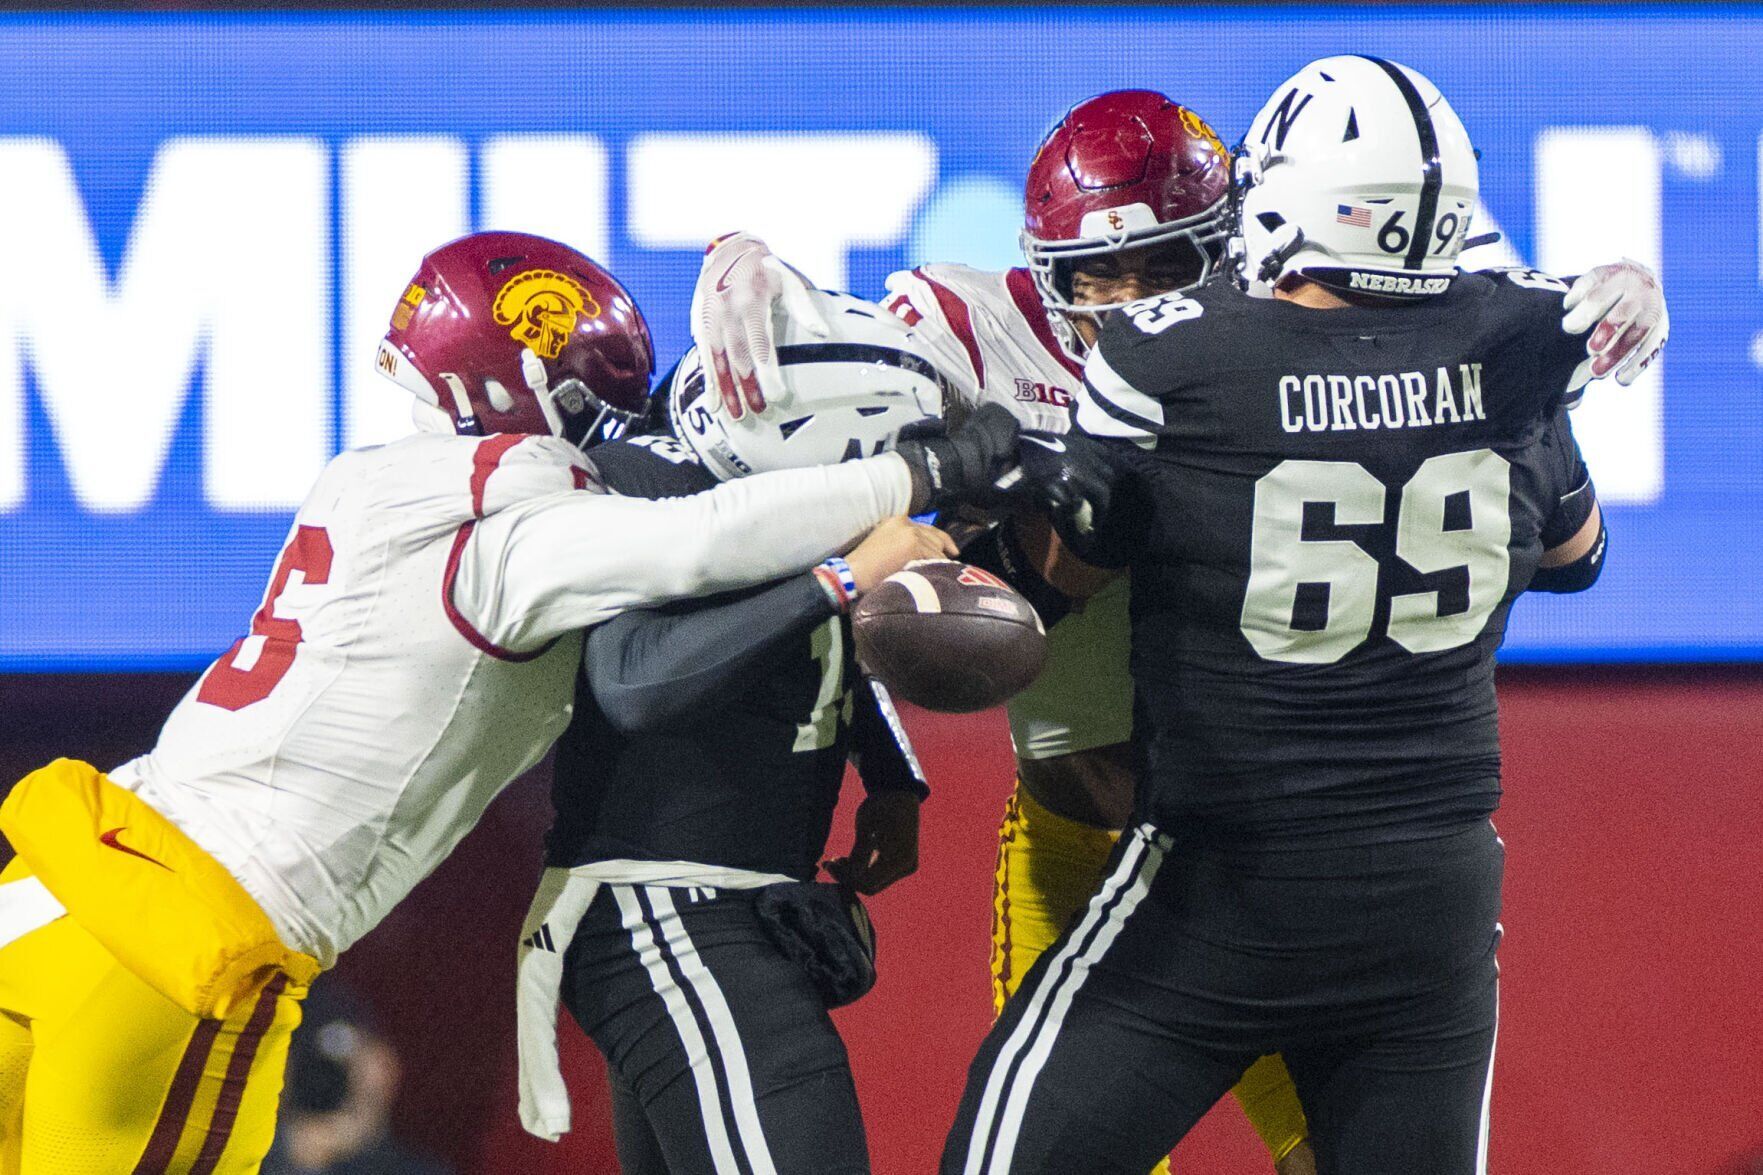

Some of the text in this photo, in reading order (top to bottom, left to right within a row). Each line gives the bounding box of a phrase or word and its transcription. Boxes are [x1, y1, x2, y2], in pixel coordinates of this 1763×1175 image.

[1260, 87, 1314, 152] N
[1350, 271, 1450, 295] NEBRASK
[379, 347, 398, 377] ON!
[1014, 377, 1071, 408] B1G
[1279, 363, 1487, 433] CORCORAN
[1240, 448, 1511, 665] 69
[792, 614, 853, 753] 1
